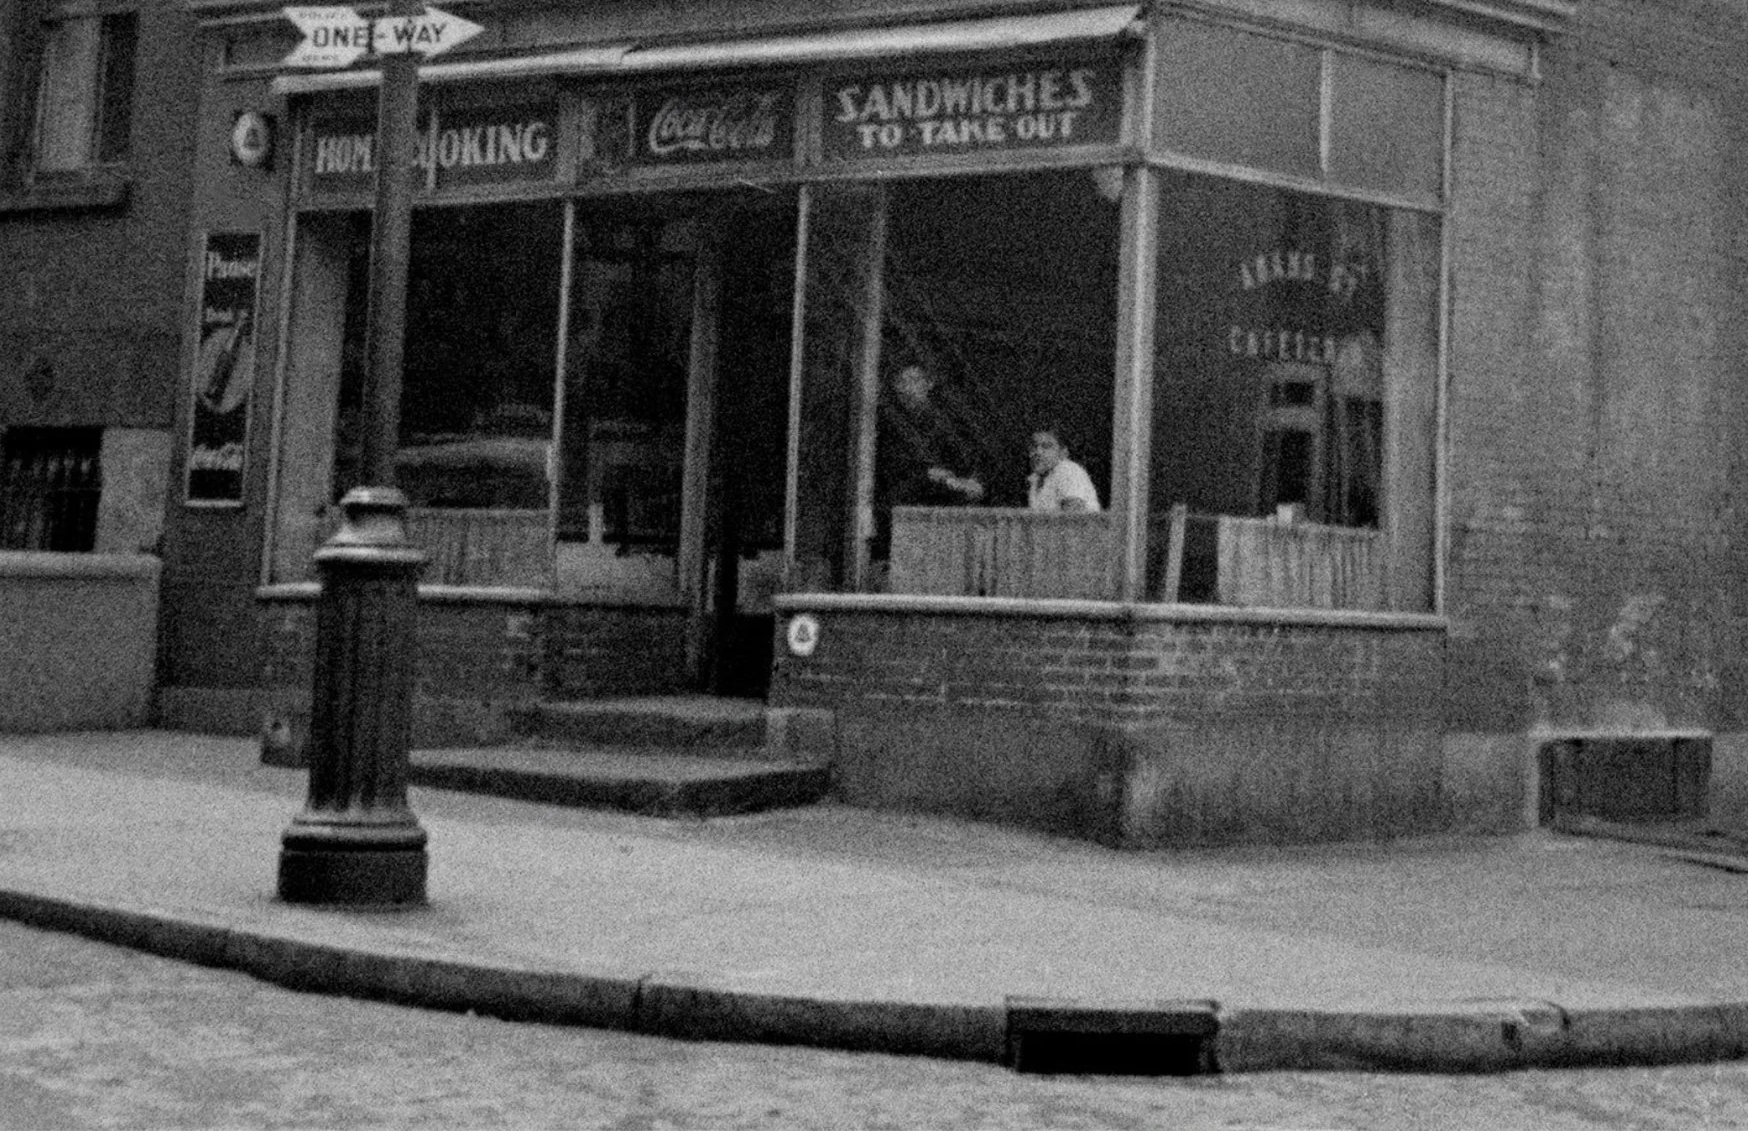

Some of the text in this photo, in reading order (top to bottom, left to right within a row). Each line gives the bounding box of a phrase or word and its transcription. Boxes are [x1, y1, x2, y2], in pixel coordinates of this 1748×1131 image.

[836, 68, 1096, 123] SANDWICHES
[856, 110, 1078, 150] TO TAKE OUT
[314, 133, 375, 174] HOM
